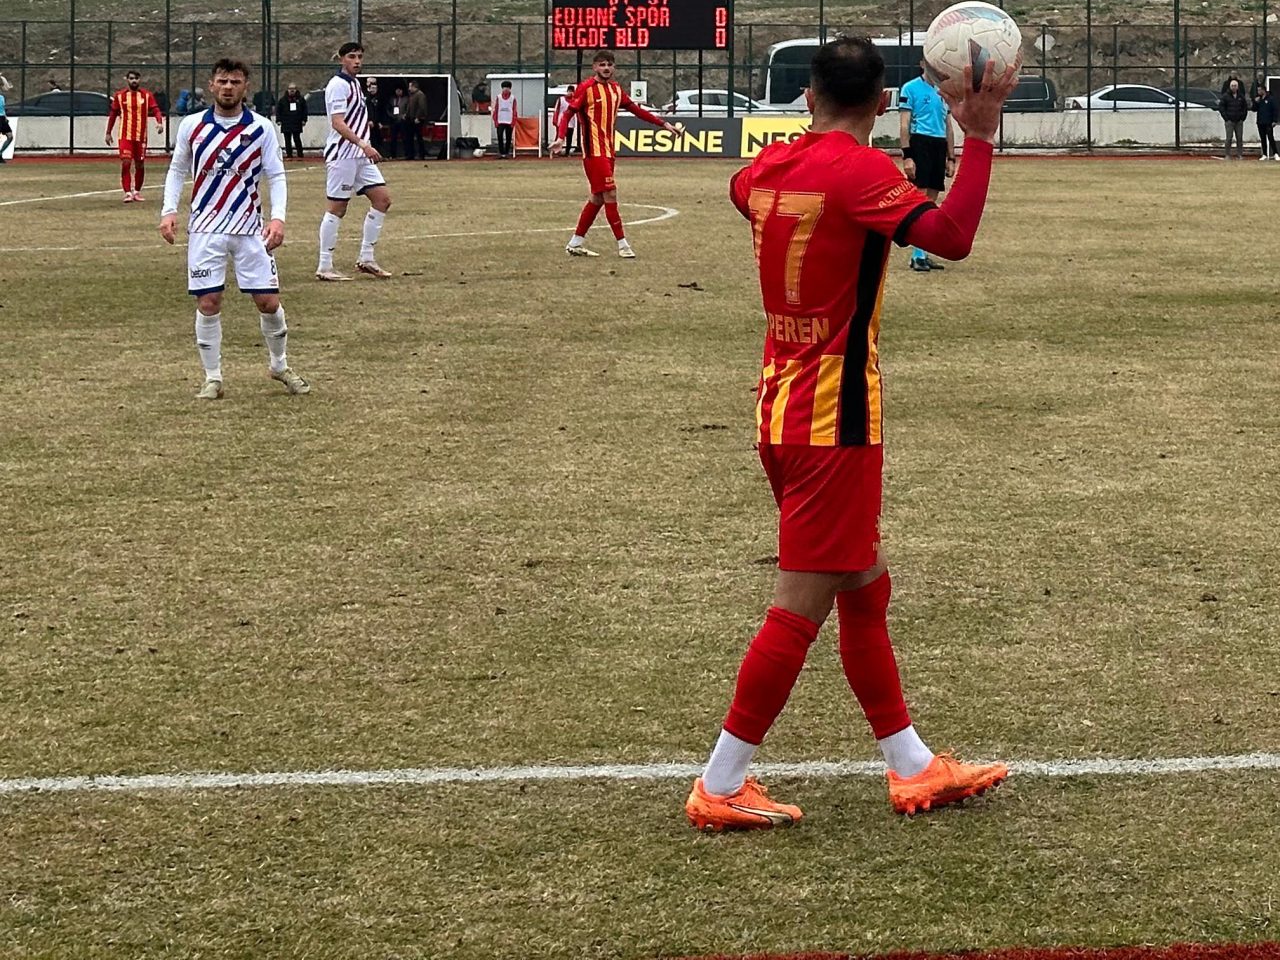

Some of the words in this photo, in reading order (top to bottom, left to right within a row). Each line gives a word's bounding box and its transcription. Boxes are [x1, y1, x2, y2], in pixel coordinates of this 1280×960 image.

[554, 7, 618, 27] EDIRNE
[625, 7, 670, 27] SPOR
[554, 28, 608, 47] NIGDE
[615, 28, 649, 47] BLD
